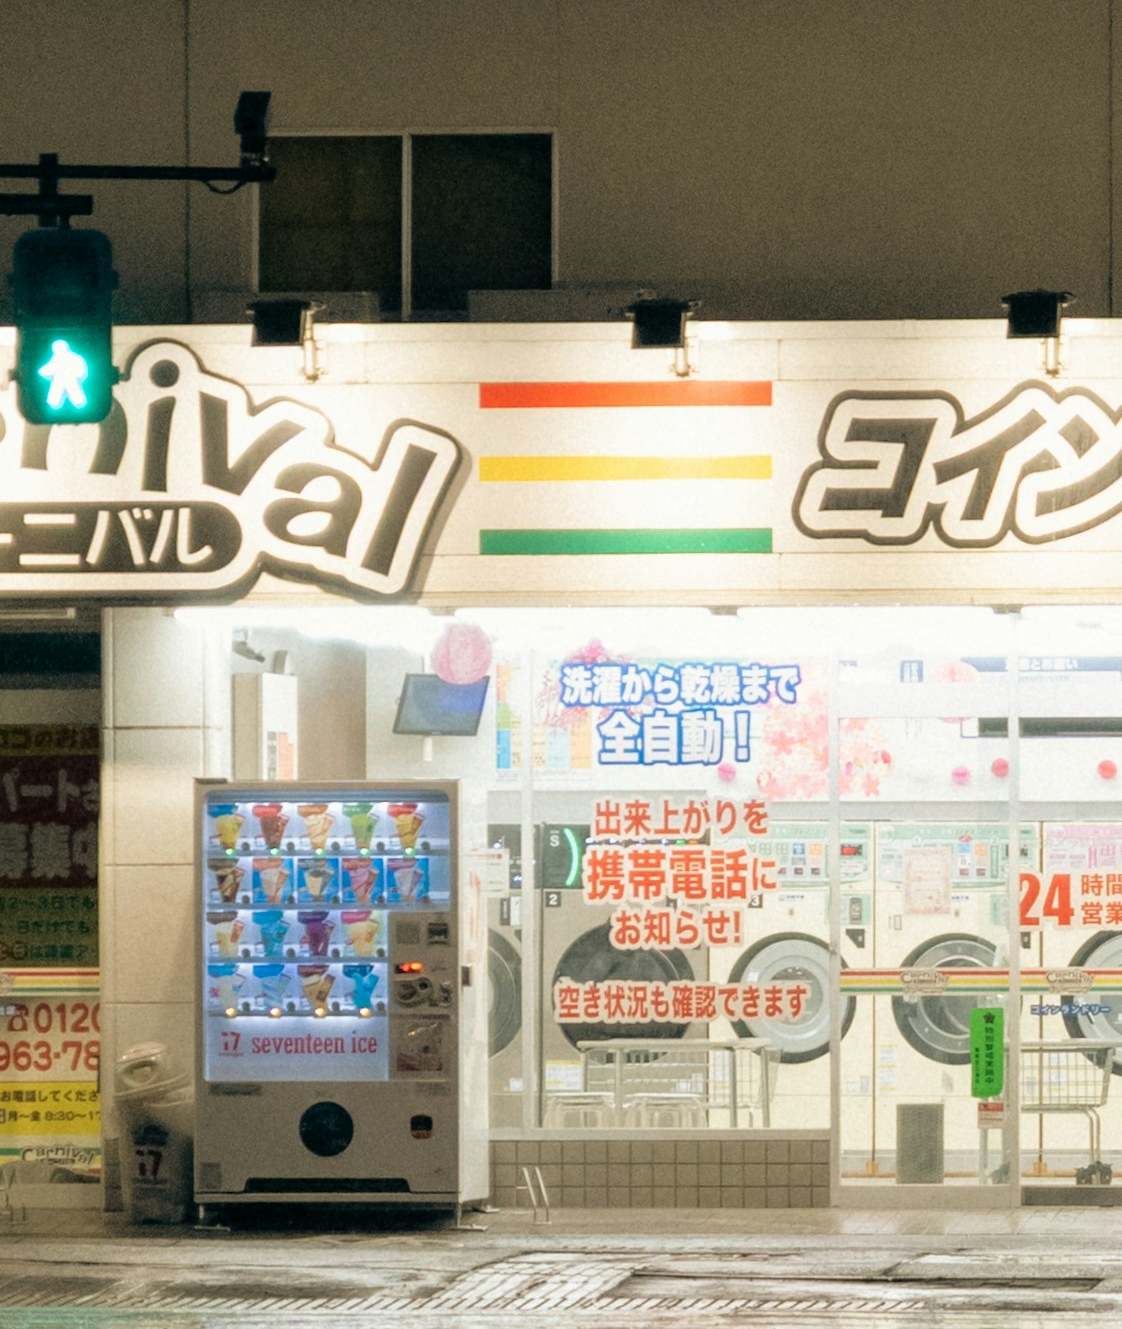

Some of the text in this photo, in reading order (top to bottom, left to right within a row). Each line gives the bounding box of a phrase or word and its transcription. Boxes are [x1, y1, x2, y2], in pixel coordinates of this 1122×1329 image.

[0, 506, 214, 566] ニバル
[560, 663, 801, 707] 洗濯から乾燥まで
[598, 708, 751, 765] 全自動！
[595, 799, 769, 837] 出来上がりを
[587, 849, 777, 901] 携帯電話に
[548, 893, 558, 905] 2
[751, 895, 761, 907] 3
[1018, 872, 1075, 926] 24
[614, 910, 742, 946] お知らせ！
[558, 985, 808, 1020] 空き状況も確認できます
[1030, 1003, 1112, 1017] コインランドリー
[251, 1030, 378, 1054] seventeen ice
[21, 1146, 96, 1167] Carnival
